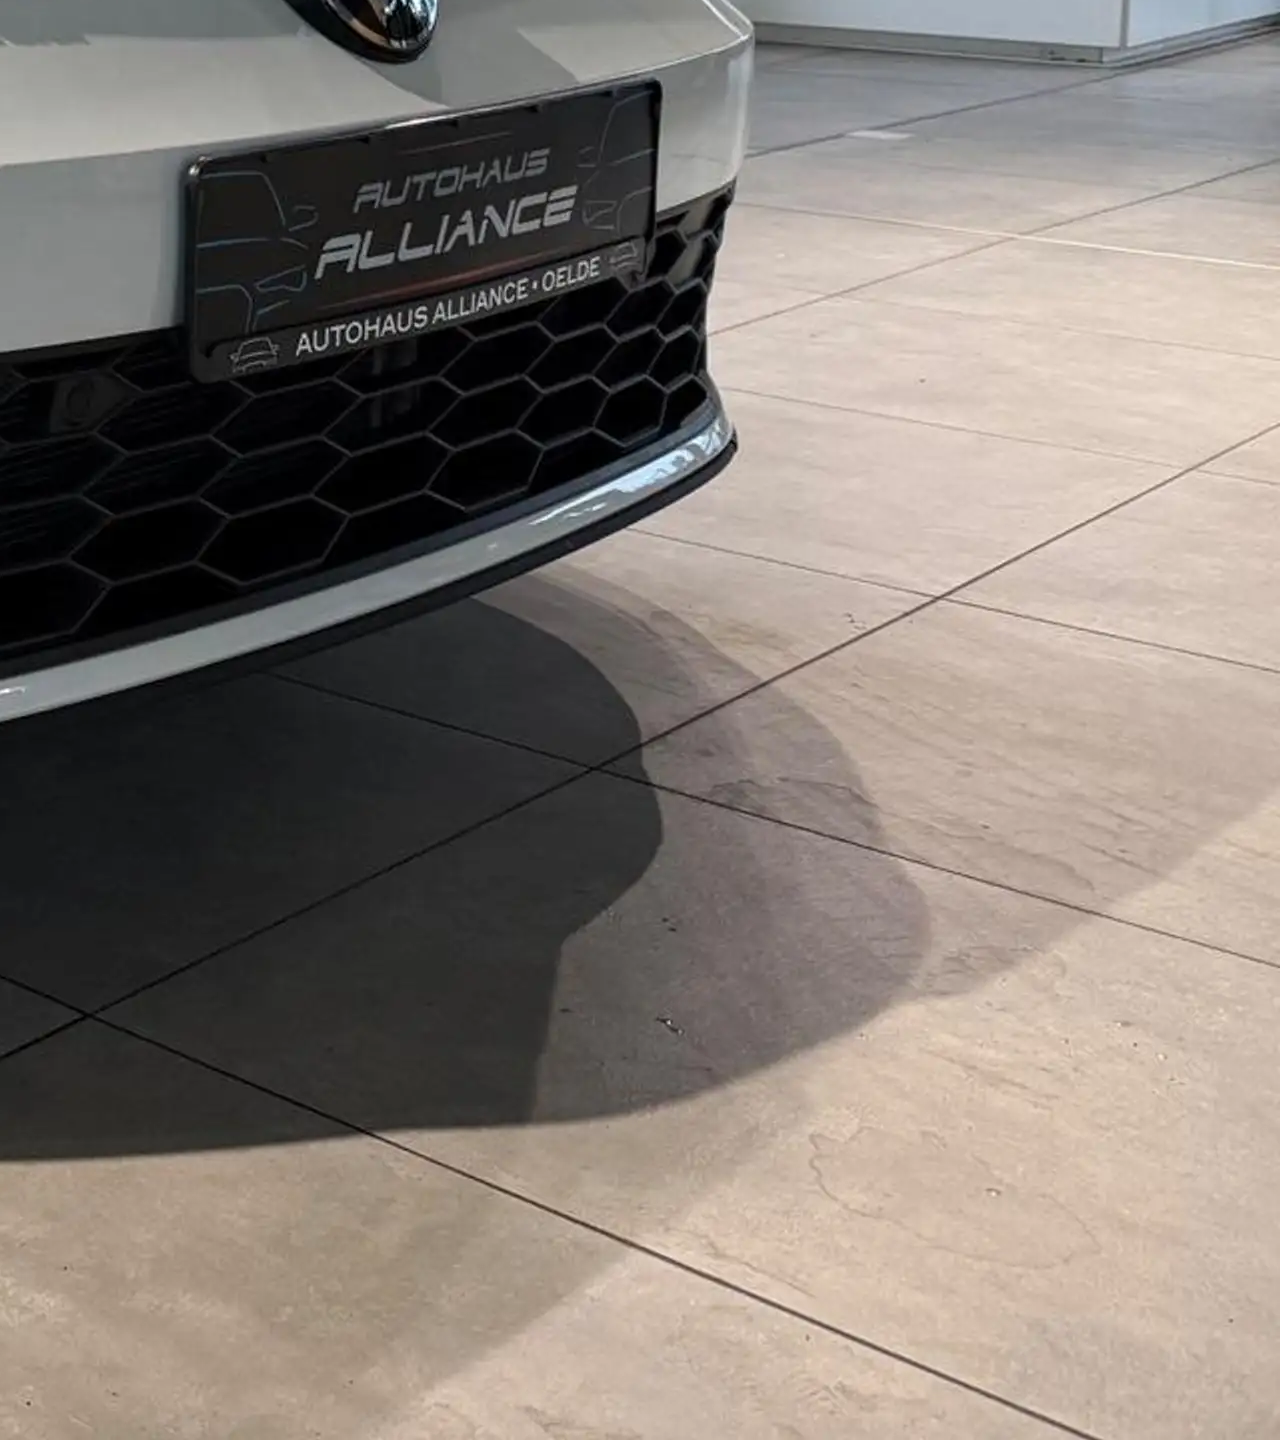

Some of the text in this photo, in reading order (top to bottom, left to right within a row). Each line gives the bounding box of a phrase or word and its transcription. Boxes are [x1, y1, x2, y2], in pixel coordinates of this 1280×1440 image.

[352, 147, 551, 214] AUTOHAUS
[313, 185, 579, 280] ALLIANCE
[295, 256, 602, 357] AUTOHAUS ALLIANCE OELDE
